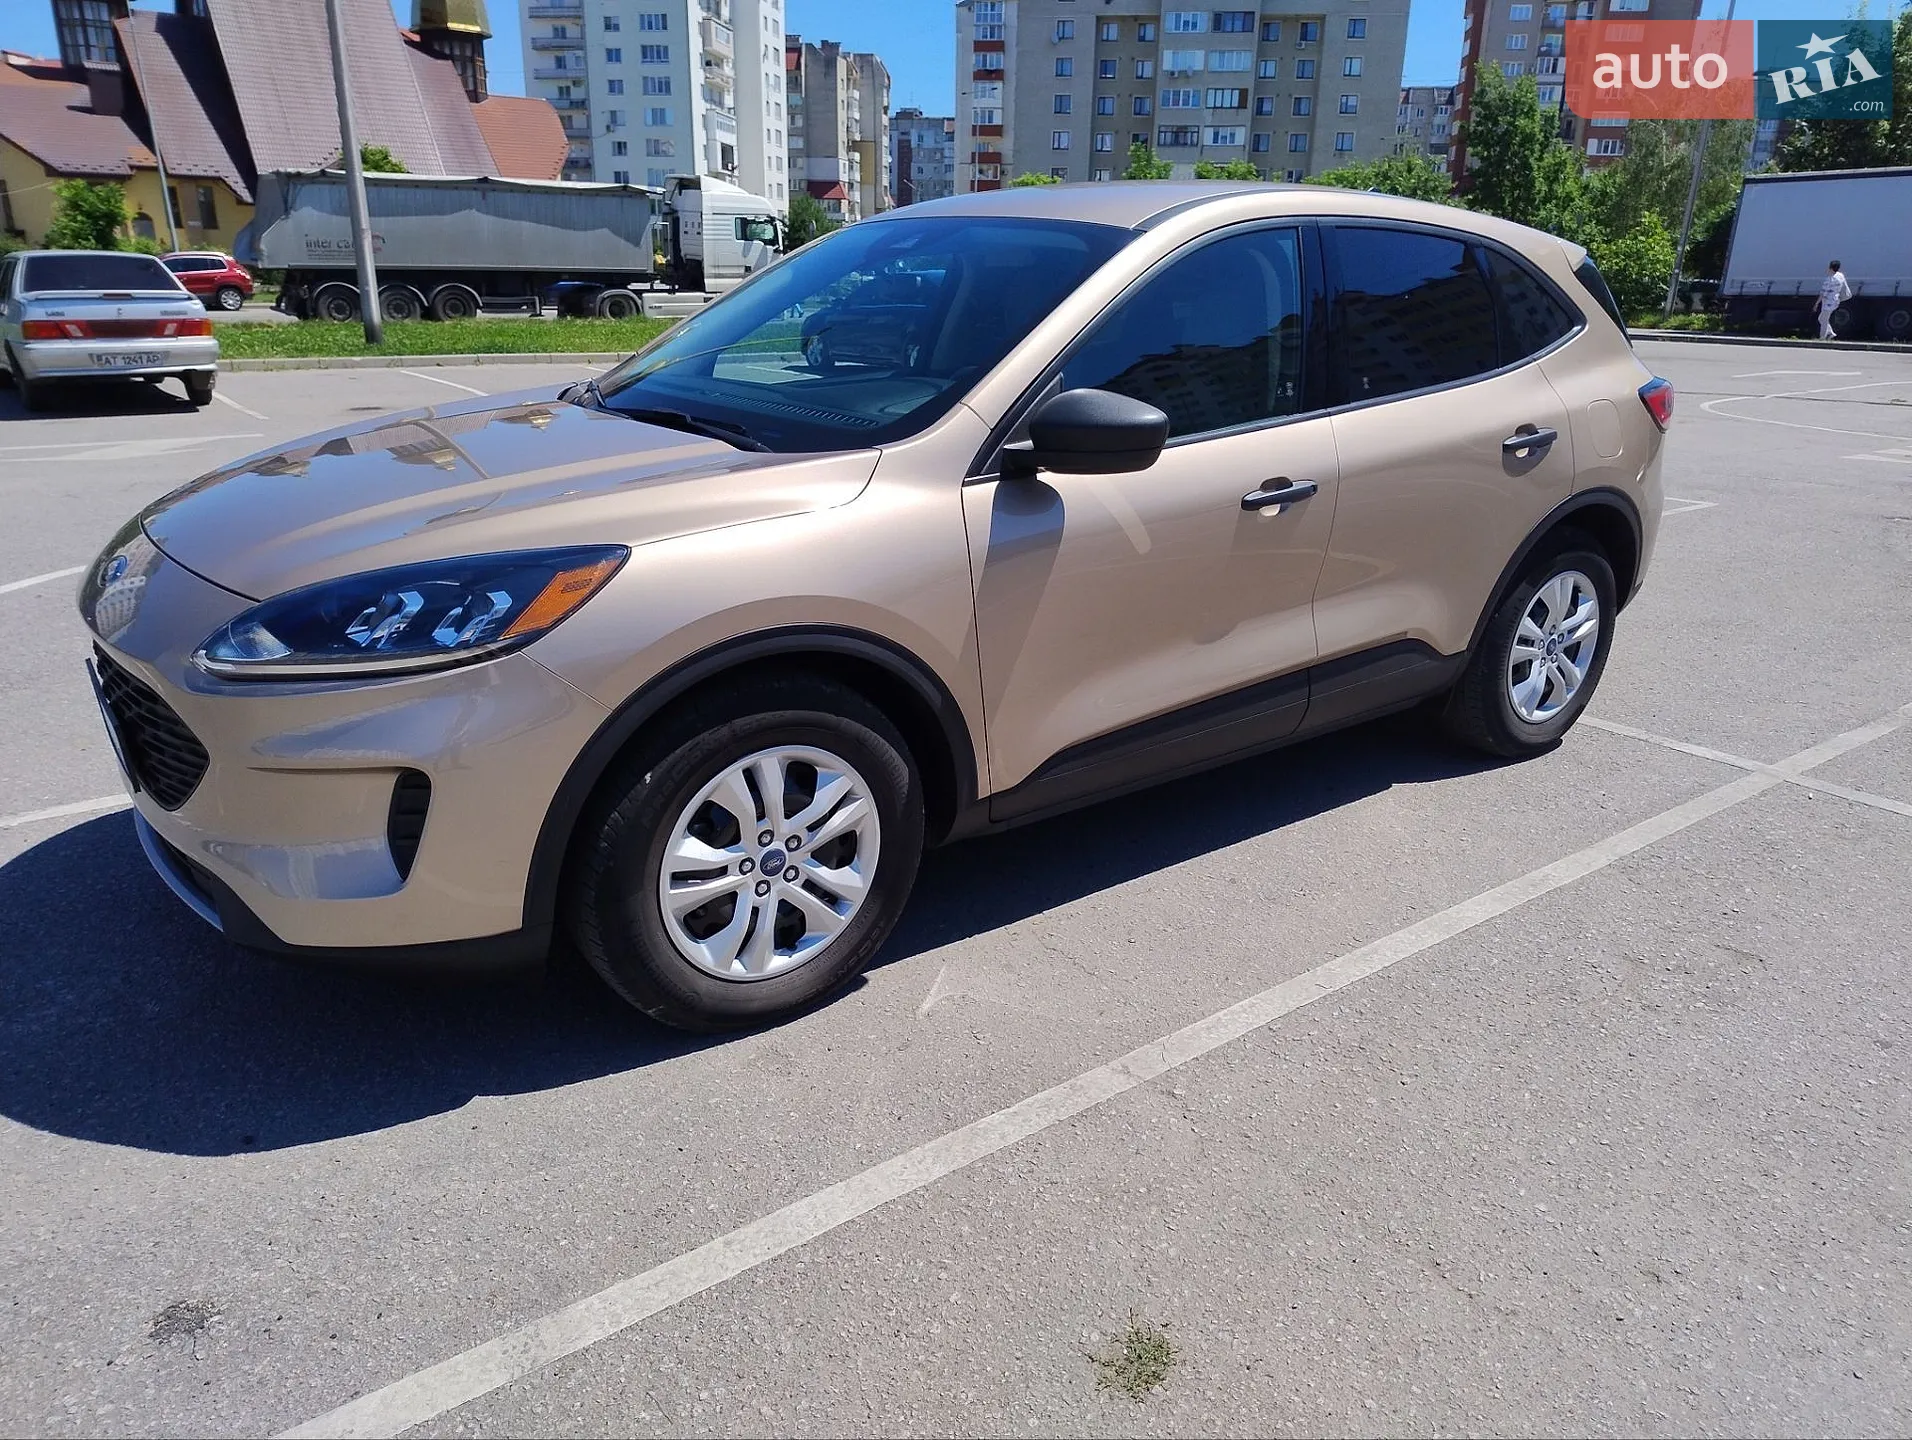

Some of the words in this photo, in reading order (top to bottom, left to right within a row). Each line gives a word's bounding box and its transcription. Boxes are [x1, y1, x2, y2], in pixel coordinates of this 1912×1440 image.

[104, 355, 117, 366] AT
[122, 355, 143, 365] 1241
[146, 354, 159, 364] AP
